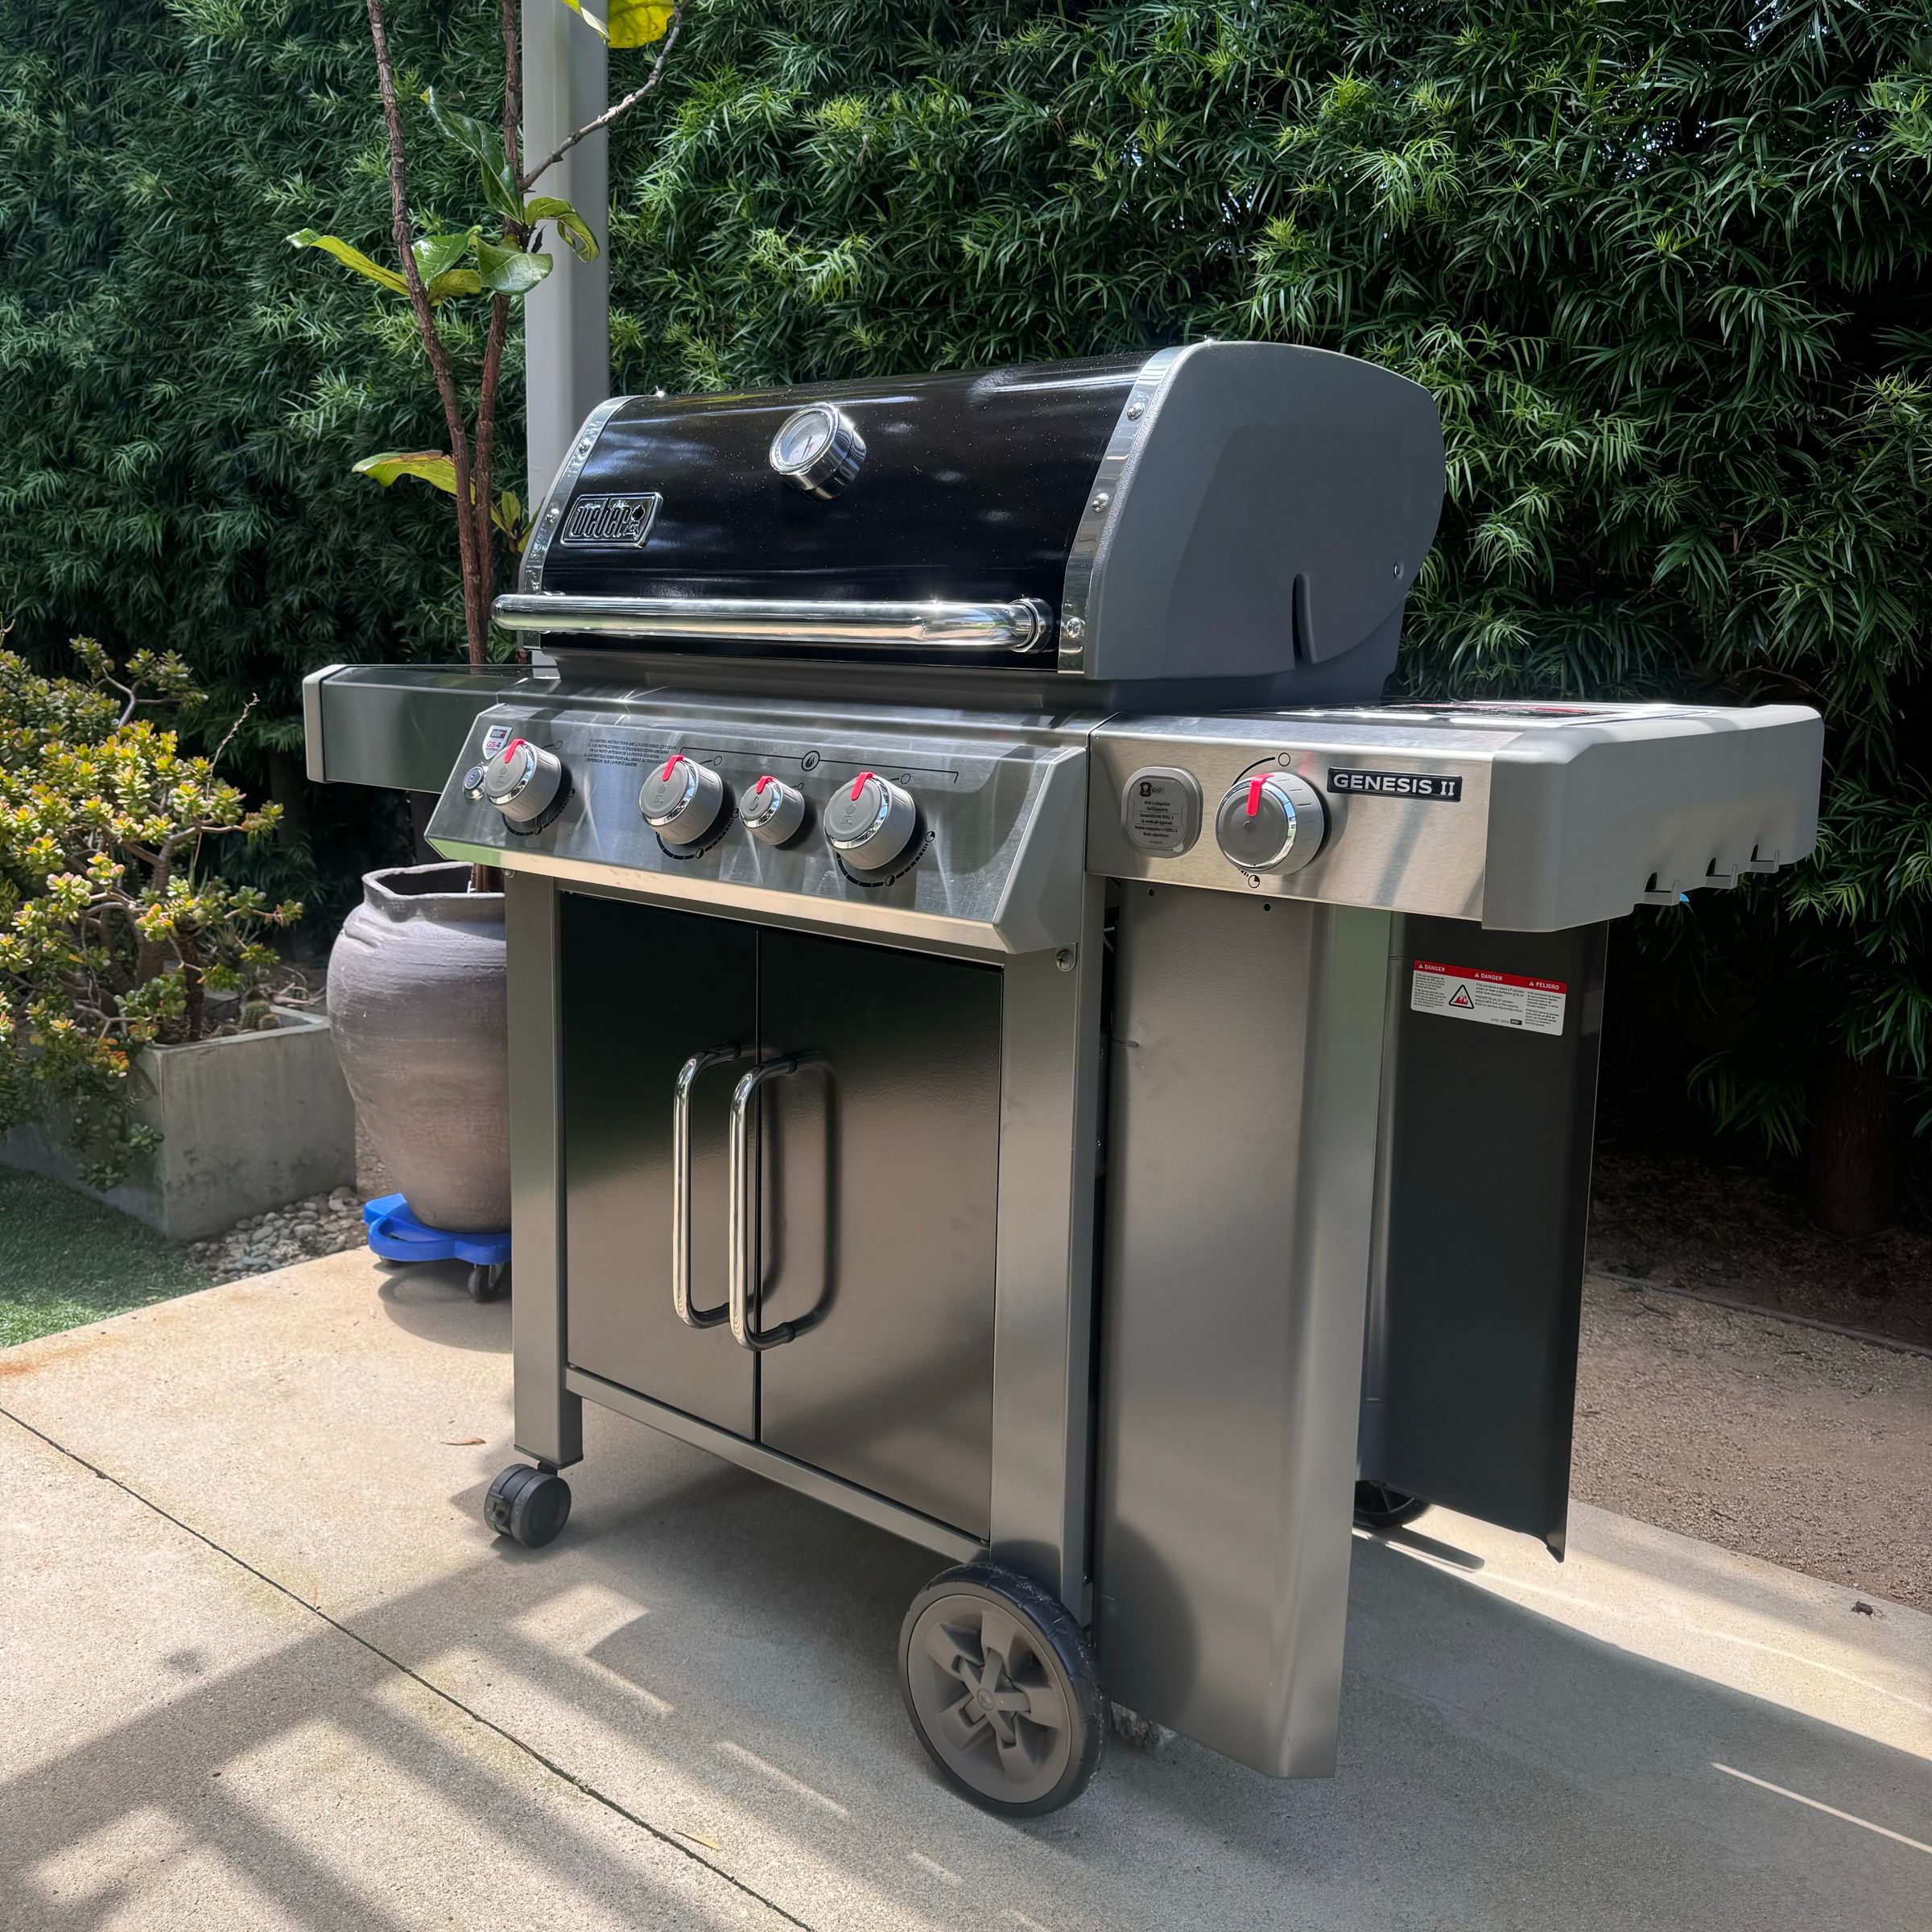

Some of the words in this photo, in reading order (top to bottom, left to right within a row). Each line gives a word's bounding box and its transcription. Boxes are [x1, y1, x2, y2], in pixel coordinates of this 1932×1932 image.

[569, 498, 632, 538] weber
[1333, 774, 1433, 795] GENESIS
[1440, 781, 1455, 796] II
[1480, 973, 1503, 981] DANGER
[1535, 981, 1559, 990] PELIGRO
